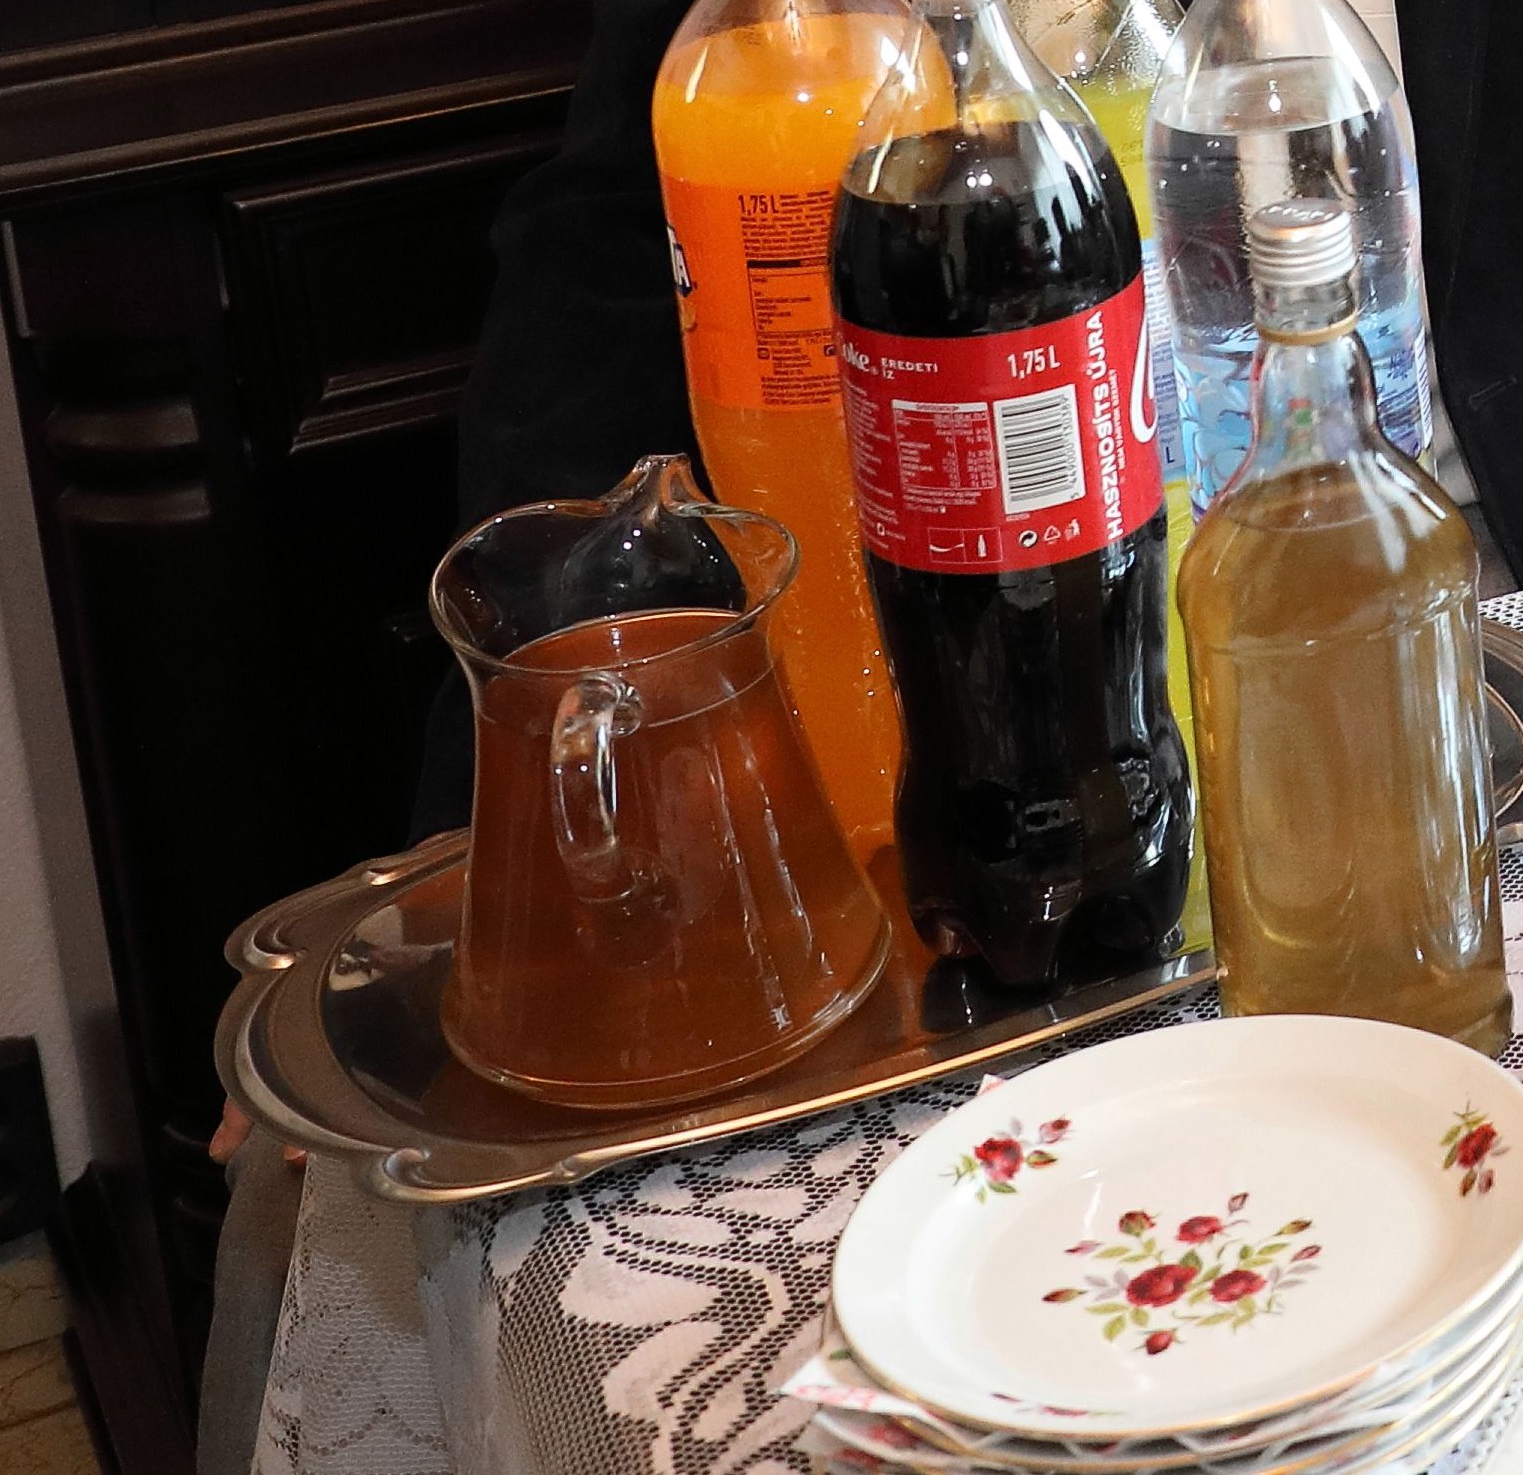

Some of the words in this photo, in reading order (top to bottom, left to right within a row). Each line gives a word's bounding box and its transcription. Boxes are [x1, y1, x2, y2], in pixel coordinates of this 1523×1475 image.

[737, 193, 769, 217] 1,75
[770, 195, 780, 215] L
[1006, 348, 1046, 380] 1,75
[1048, 344, 1061, 369] L
[1086, 311, 1109, 380] ÚJRA
[880, 357, 939, 374] EREDETI
[1091, 382, 1125, 540] HASZNOSÍTS
